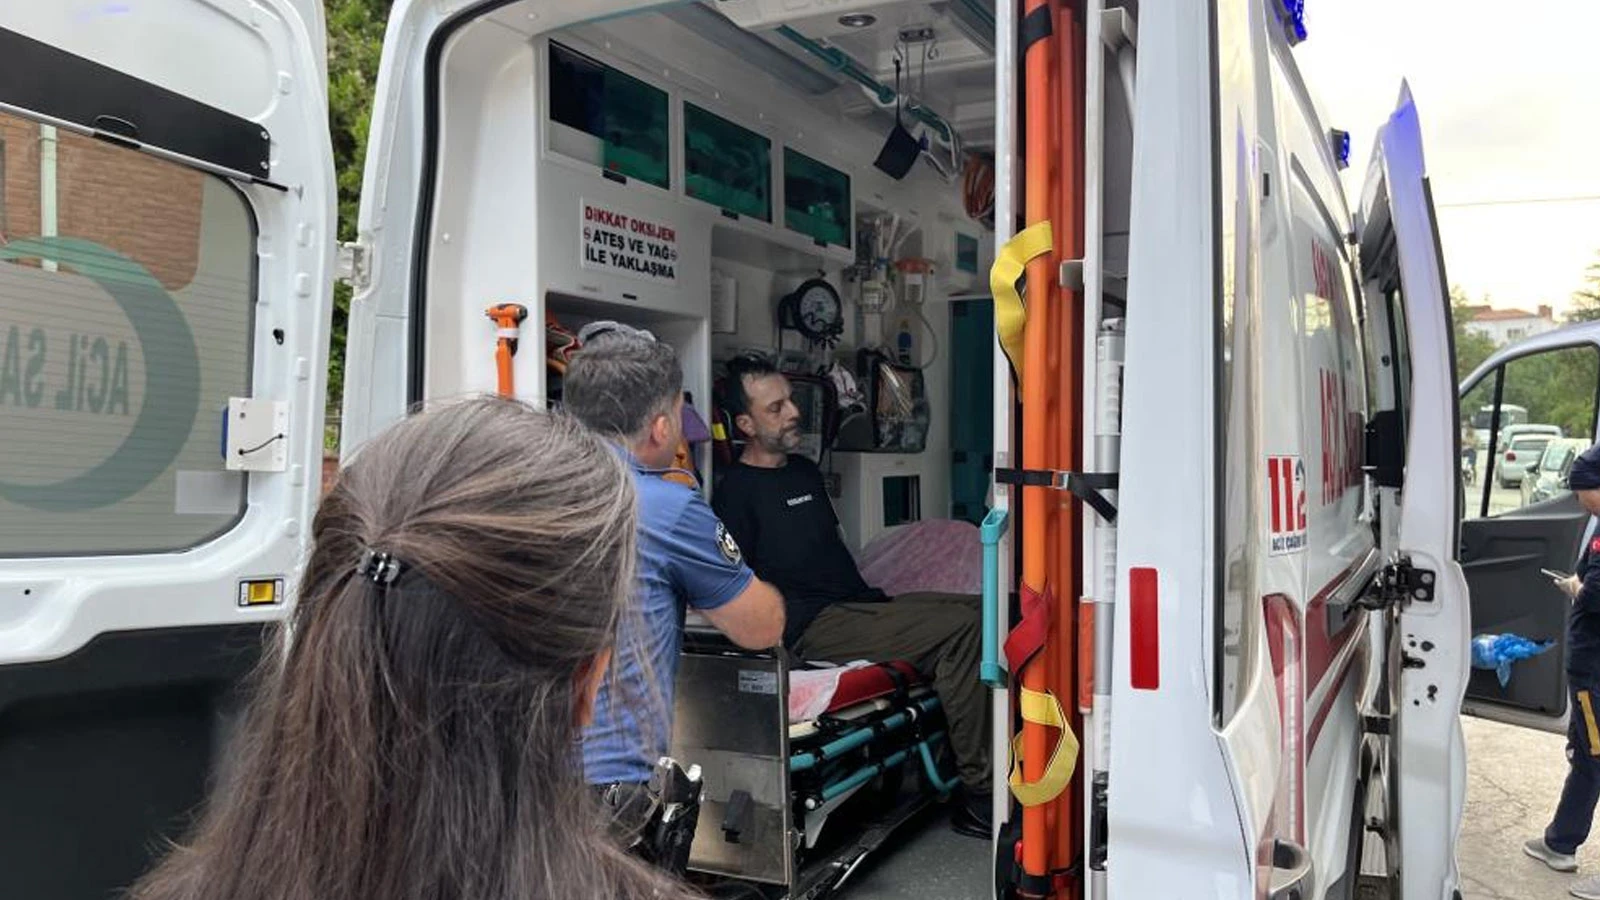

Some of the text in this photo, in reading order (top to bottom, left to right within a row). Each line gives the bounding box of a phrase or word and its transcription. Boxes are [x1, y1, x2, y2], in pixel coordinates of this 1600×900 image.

[586, 243, 675, 279] İLE YAKLAŞMA
[593, 230, 670, 260] ATEŞ VE YAĞ
[1267, 457, 1306, 533] 112
